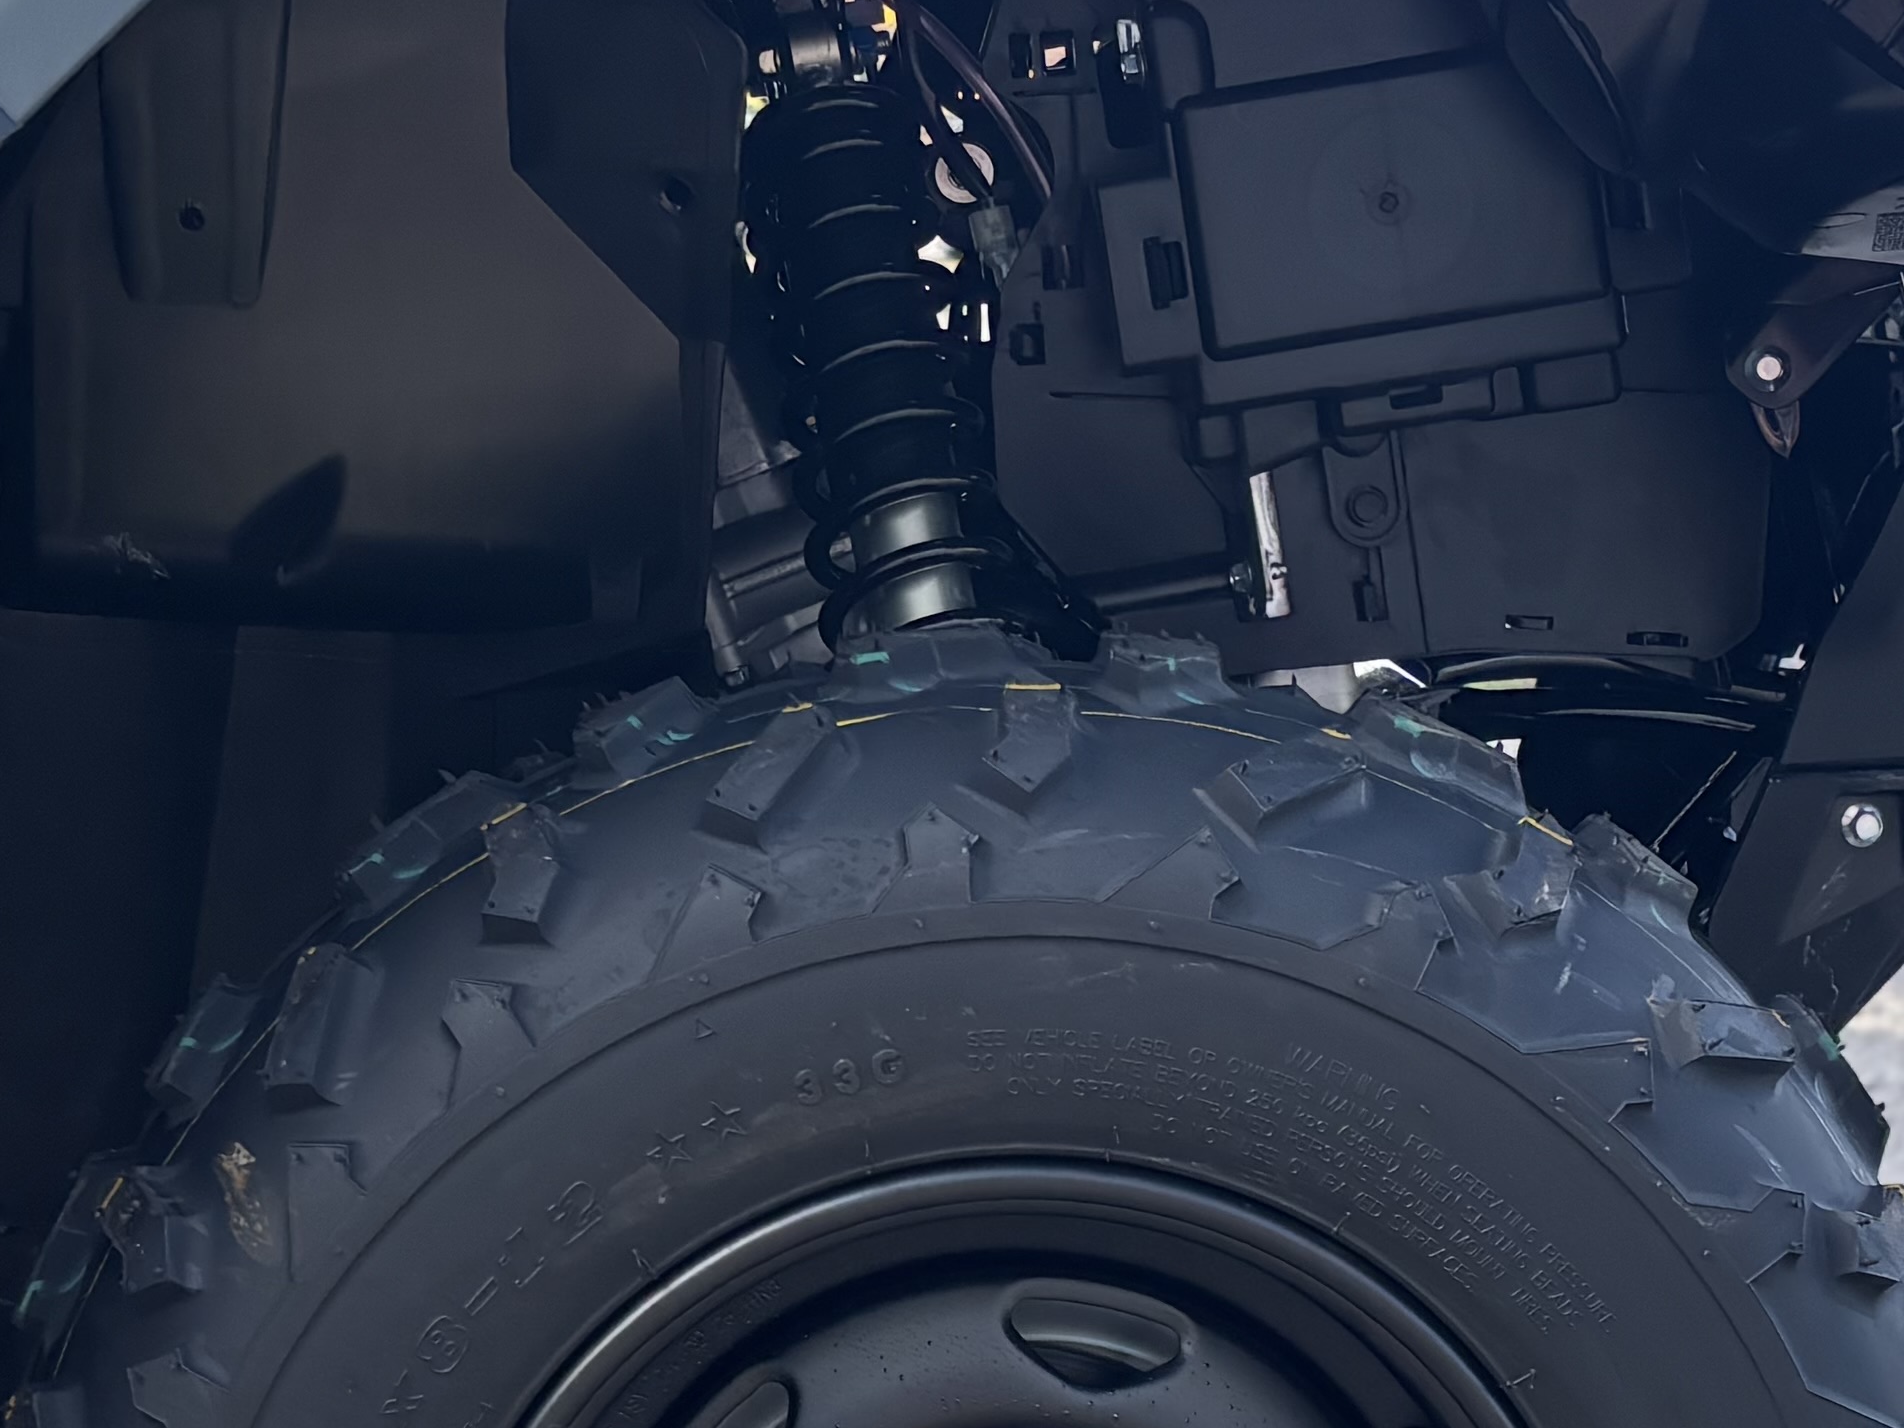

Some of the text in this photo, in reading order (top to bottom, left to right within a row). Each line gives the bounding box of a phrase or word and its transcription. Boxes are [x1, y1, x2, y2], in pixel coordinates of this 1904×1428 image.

[966, 1028, 1007, 1047] SEE
[1024, 1027, 1102, 1049] VEHICLE
[1112, 1034, 1176, 1060] LABEL
[1402, 1133, 1445, 1162] FOR
[1448, 1164, 1540, 1244] OPERATING
[967, 1052, 996, 1072] DO
[1154, 1063, 1238, 1099] BEYOND
[1408, 1163, 1463, 1206] WHEN
[1461, 1204, 1532, 1270] SEATING
